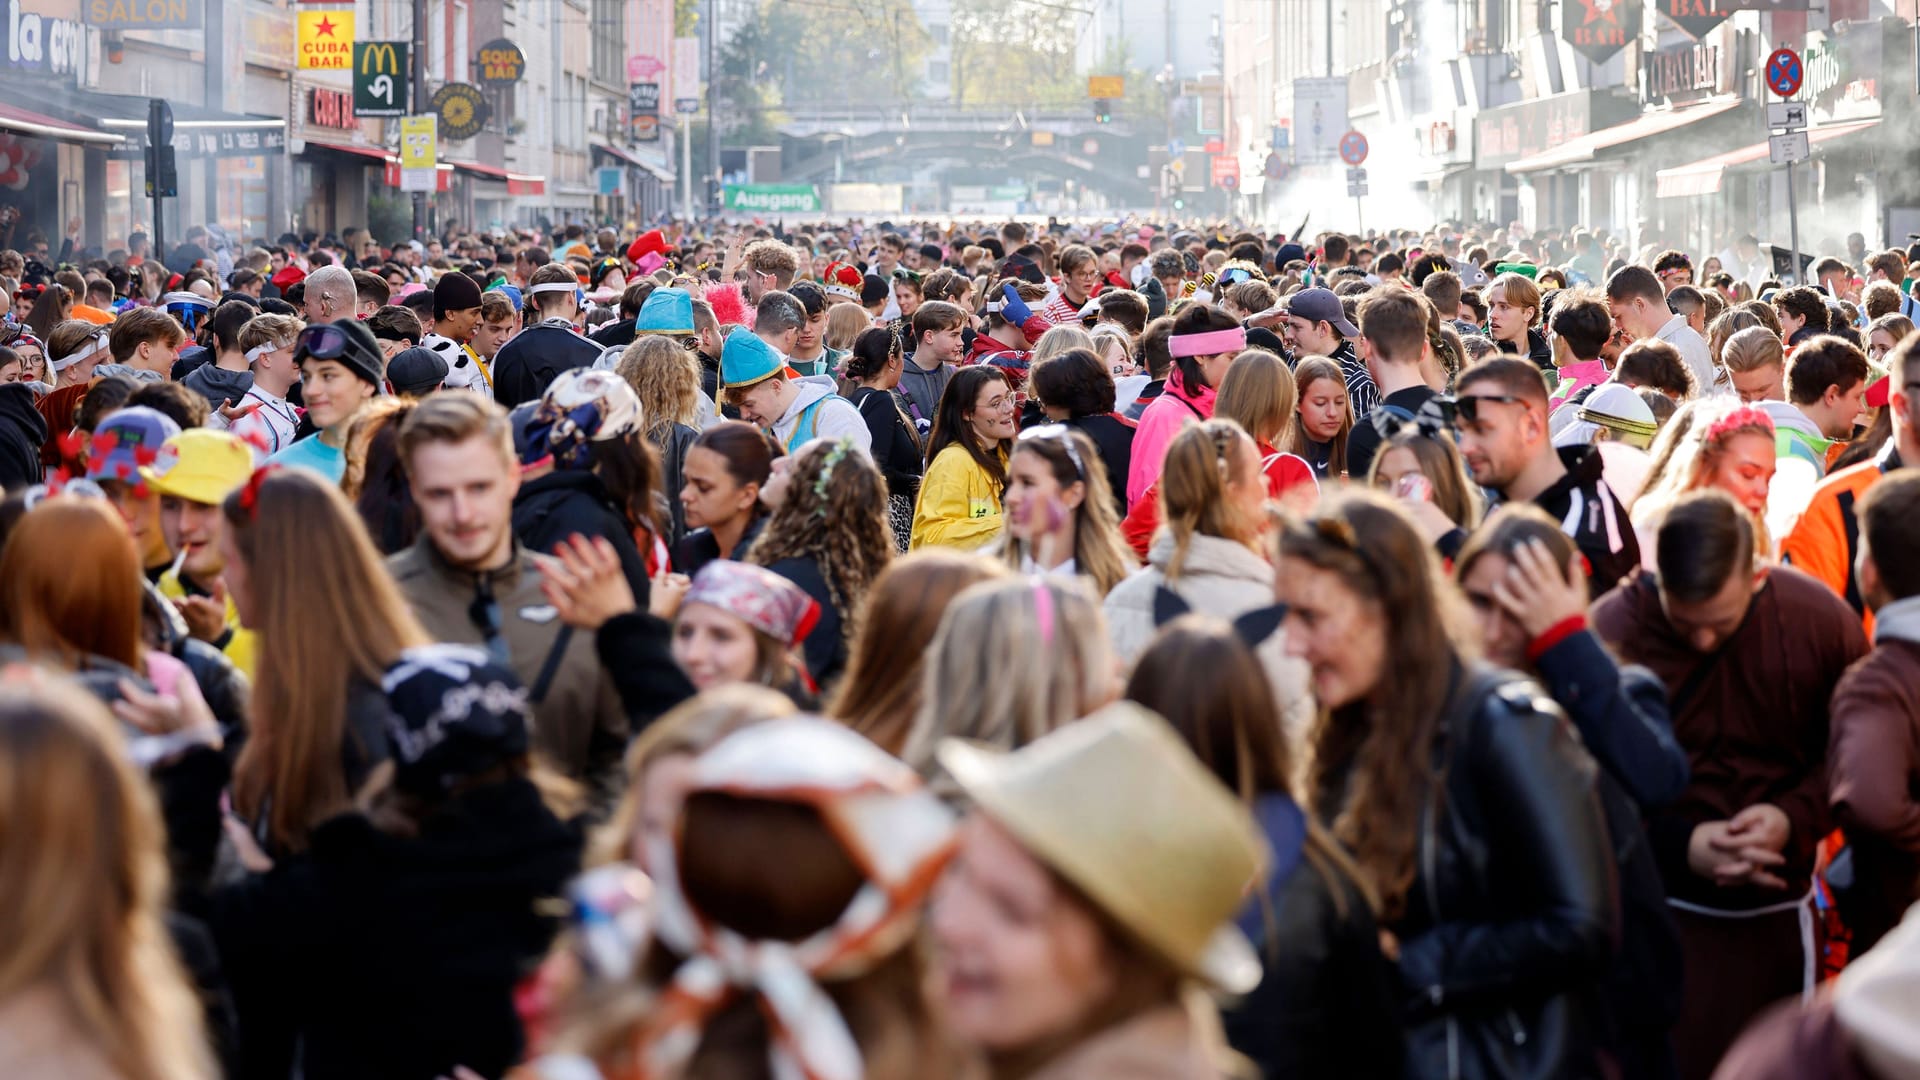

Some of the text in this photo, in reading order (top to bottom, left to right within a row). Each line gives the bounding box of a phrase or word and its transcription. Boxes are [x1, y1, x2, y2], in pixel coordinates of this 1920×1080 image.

[91, 0, 188, 23] SALON
[9, 0, 43, 62] la
[1574, 27, 1625, 46] BAR
[303, 42, 350, 54] CUBA
[310, 56, 344, 68] BAR
[480, 49, 522, 65] SOUL
[485, 64, 517, 80] BAR
[734, 190, 814, 211] Ausgang
